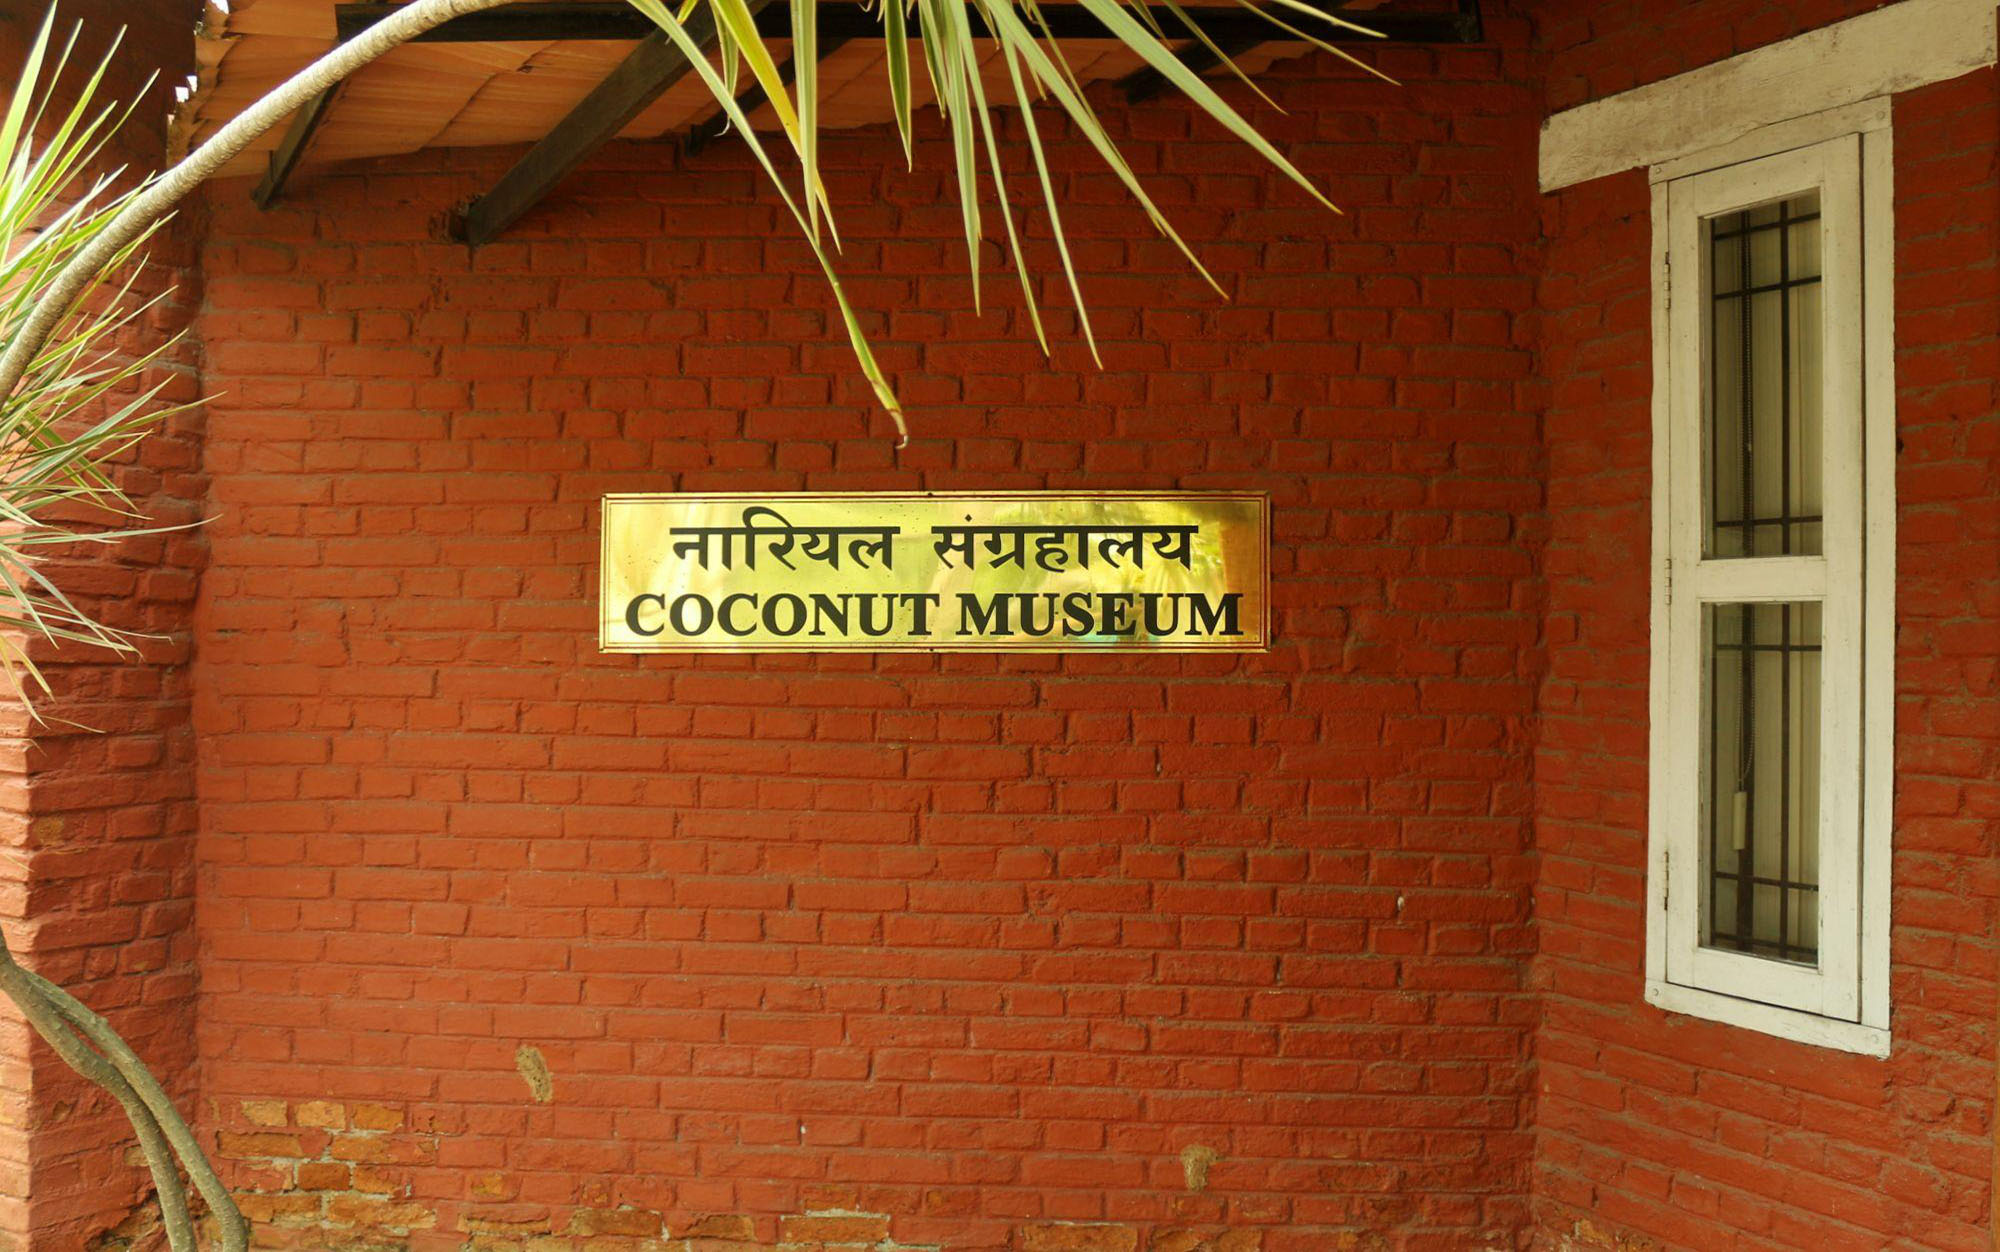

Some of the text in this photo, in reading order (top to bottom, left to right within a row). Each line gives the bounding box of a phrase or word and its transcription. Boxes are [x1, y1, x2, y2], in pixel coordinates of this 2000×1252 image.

[669, 505, 1199, 573] नारियल संग्रहालय
[625, 592, 1244, 637] COCONUT MUSEUM
